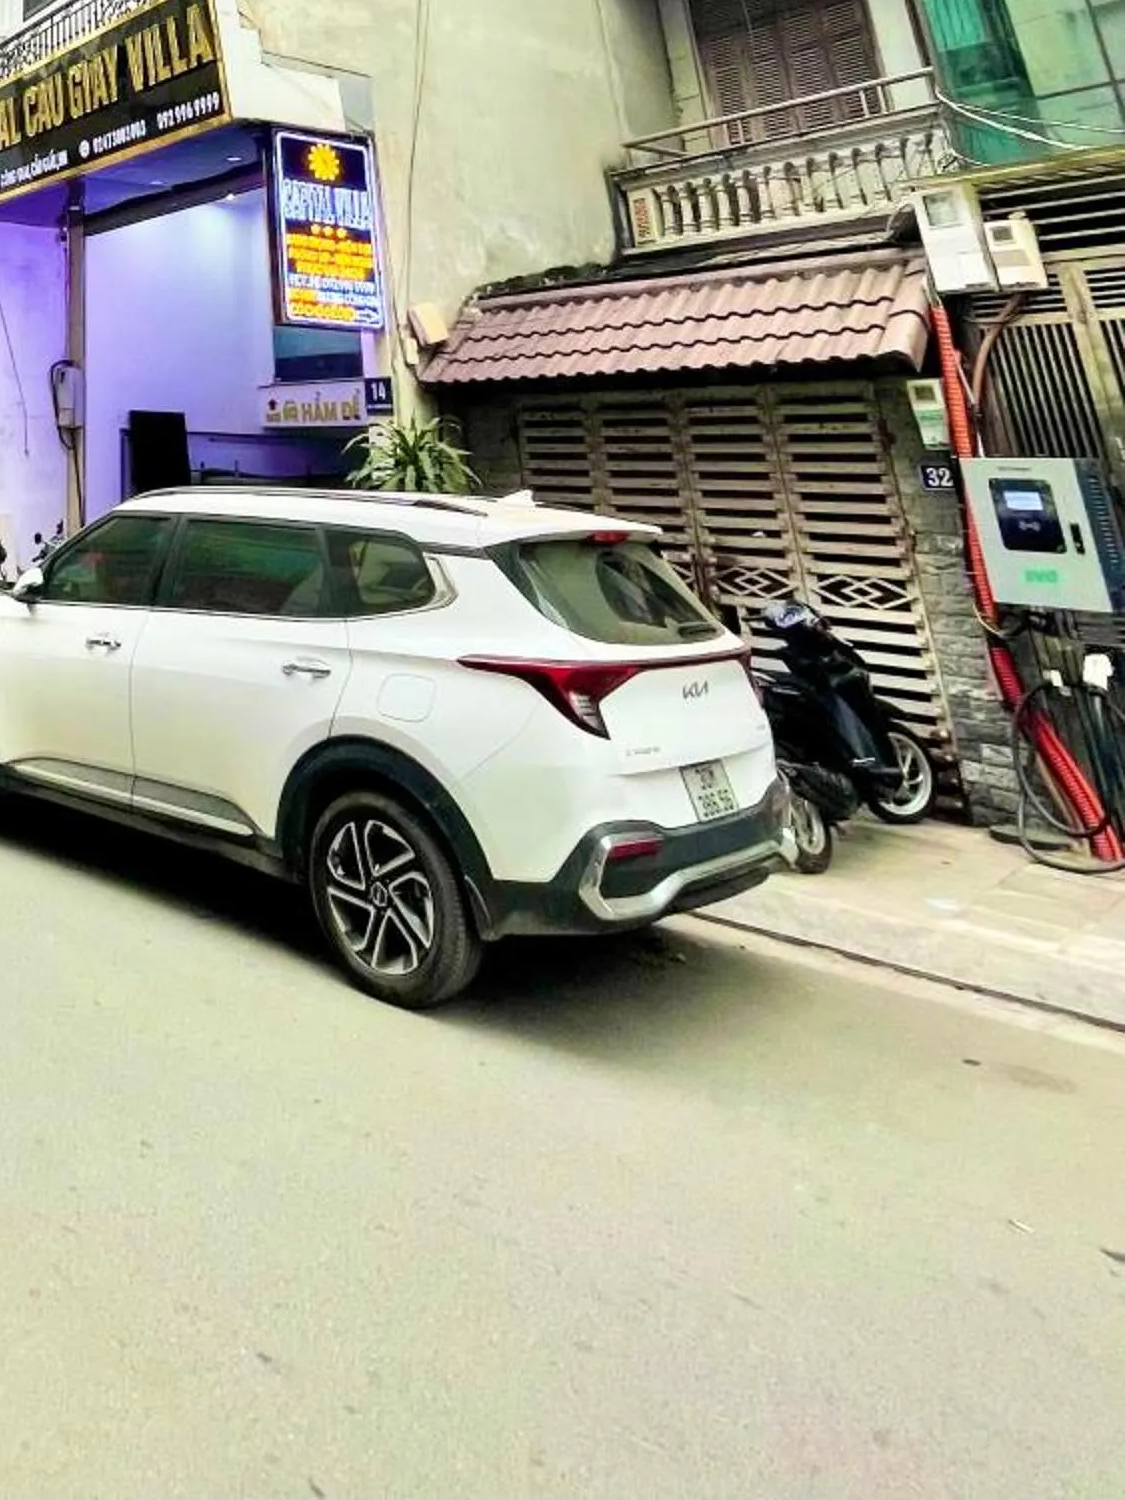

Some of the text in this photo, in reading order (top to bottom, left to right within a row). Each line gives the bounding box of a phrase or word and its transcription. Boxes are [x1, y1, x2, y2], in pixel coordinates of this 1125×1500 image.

[125, 3, 215, 93] VILLA
[371, 379, 386, 400] 14
[926, 467, 954, 487] 32
[683, 680, 709, 700] KIA
